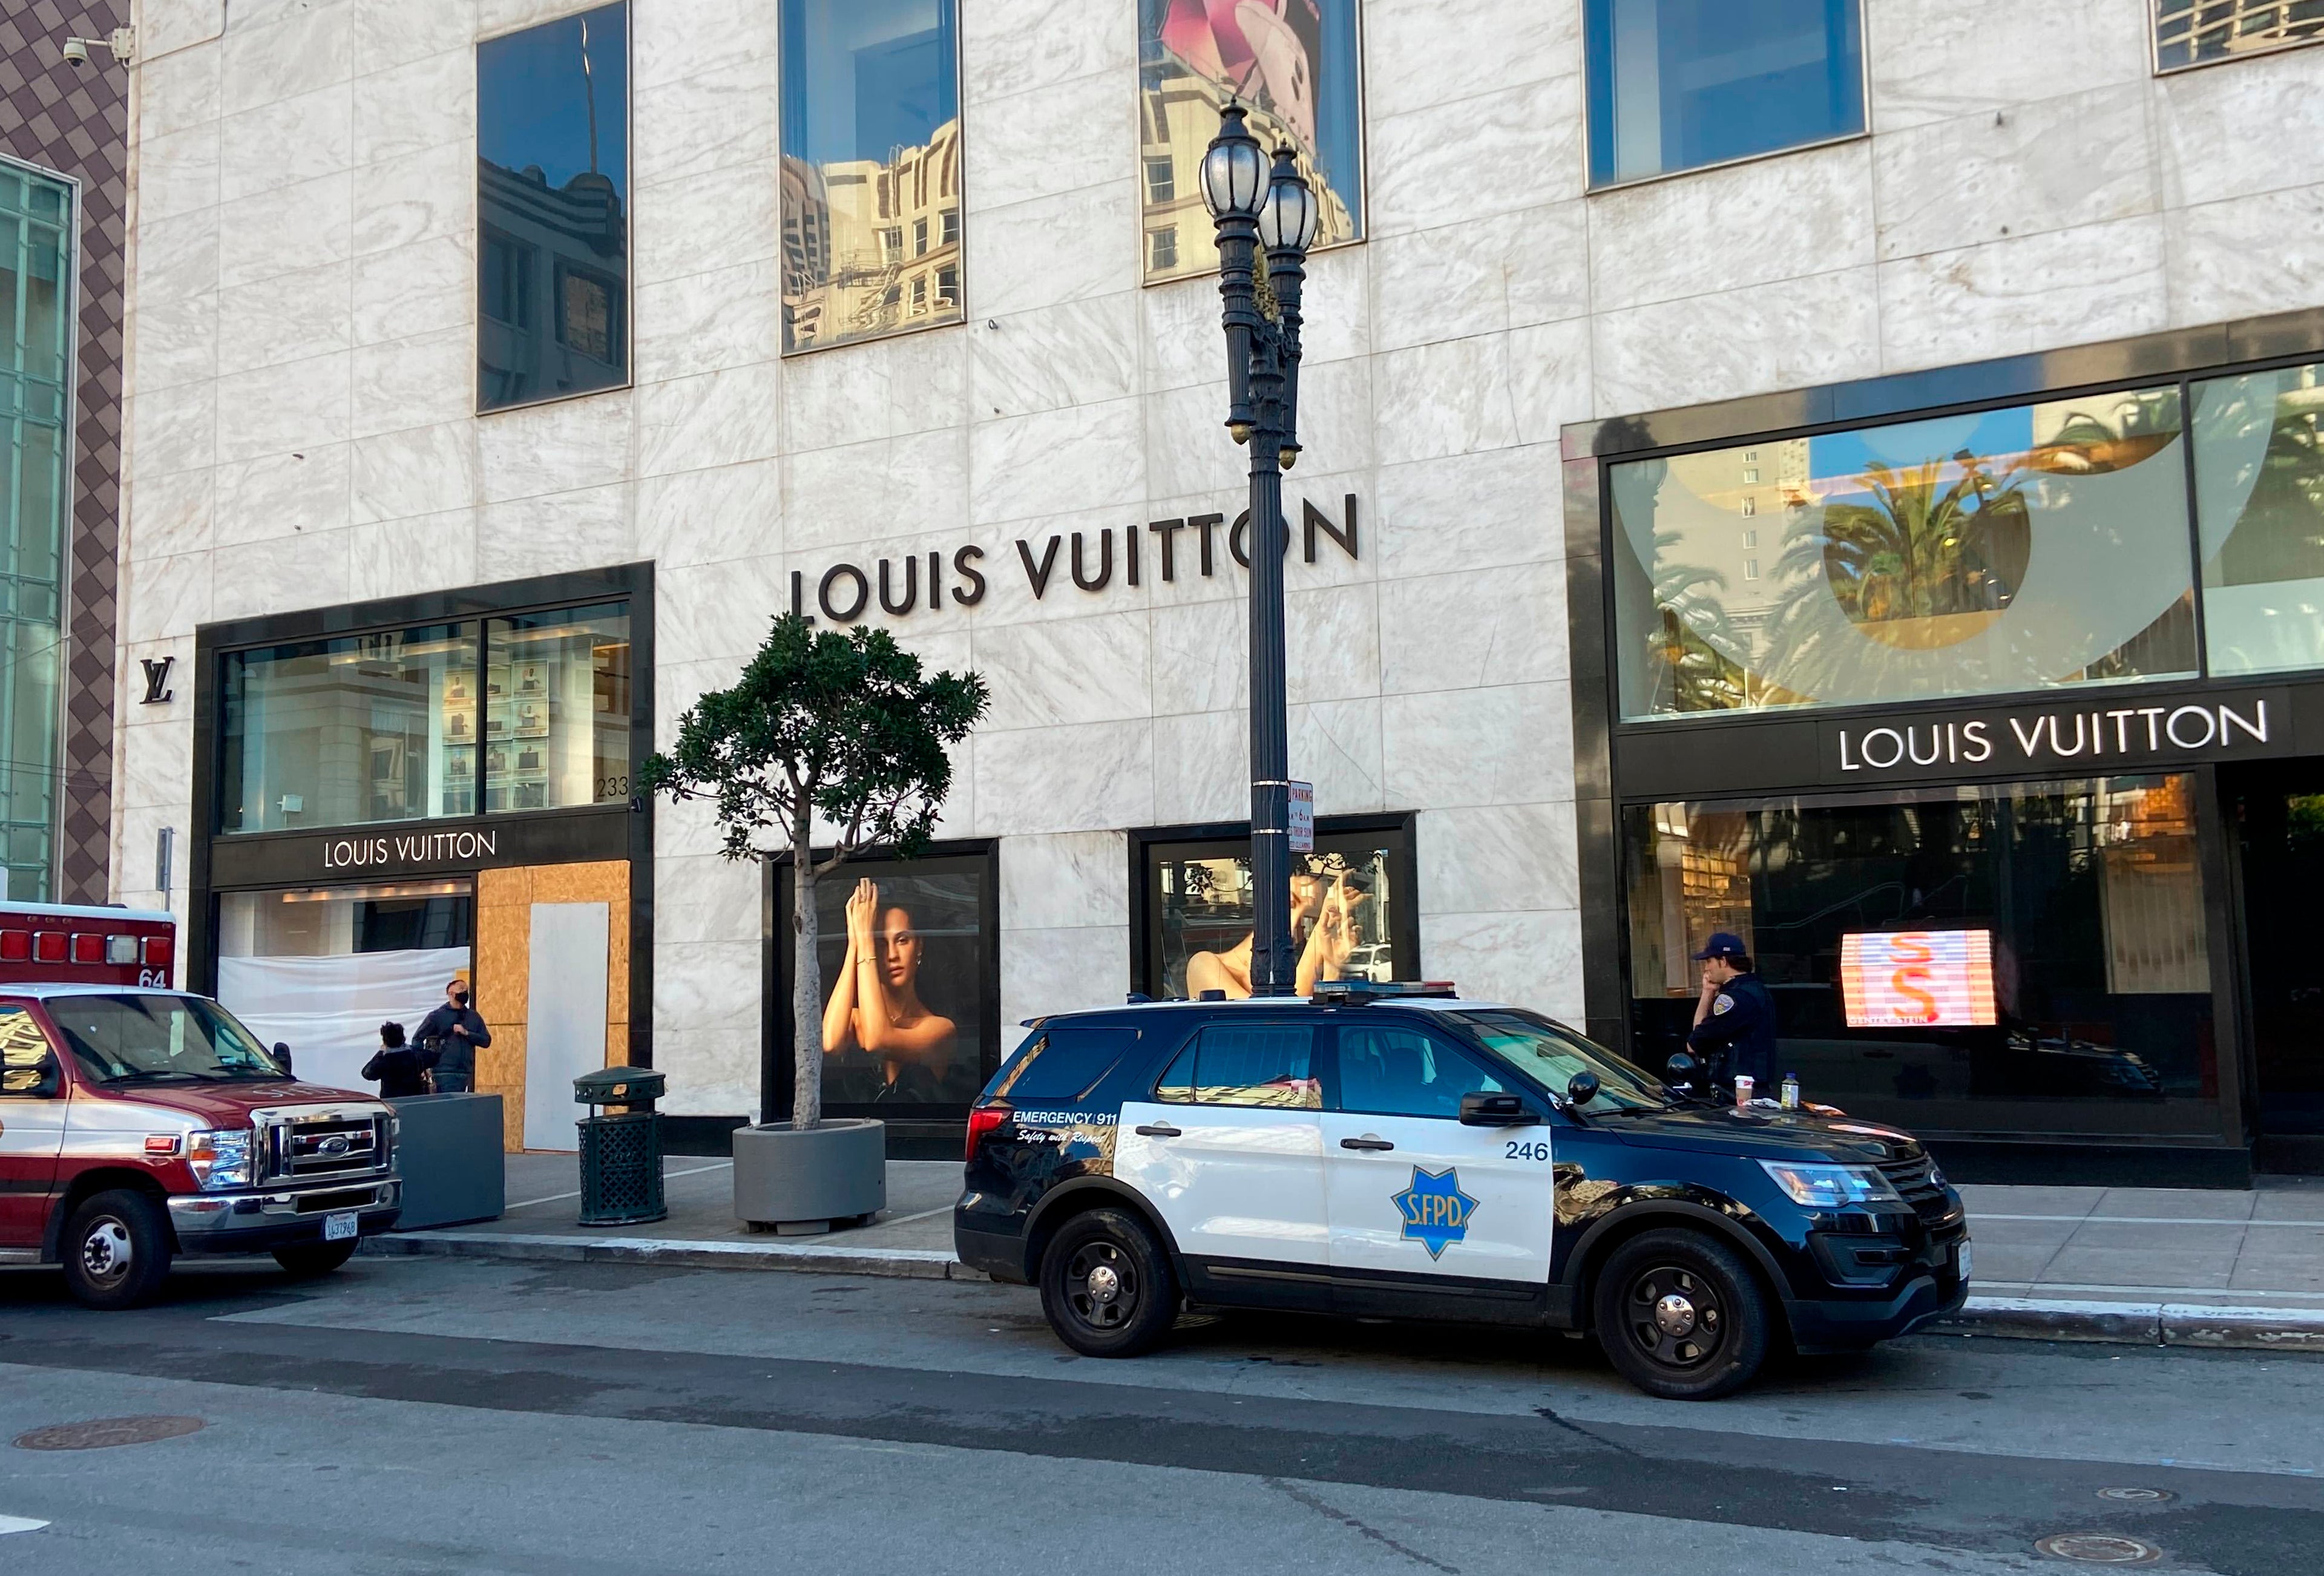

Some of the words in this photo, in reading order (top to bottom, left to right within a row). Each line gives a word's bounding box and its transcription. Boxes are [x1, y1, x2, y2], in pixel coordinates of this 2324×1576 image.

[791, 545, 985, 625] LOUIS
[1015, 493, 1358, 600] VUITTON
[1839, 720, 1992, 771] LOUIS
[2009, 699, 2268, 758] VUITTON
[597, 776, 628, 797] 233
[1299, 809, 1303, 821] 6
[324, 838, 388, 868] LOUIS
[395, 830, 496, 862] VUITTON
[139, 969, 166, 988] 64
[1013, 1111, 1092, 1124] EMERGENCY
[1097, 1113, 1117, 1125] 911
[1017, 1129, 1046, 1143] Safety
[1048, 1131, 1068, 1142] with
[1070, 1131, 1106, 1144] Respect
[1505, 1141, 1549, 1161] 246
